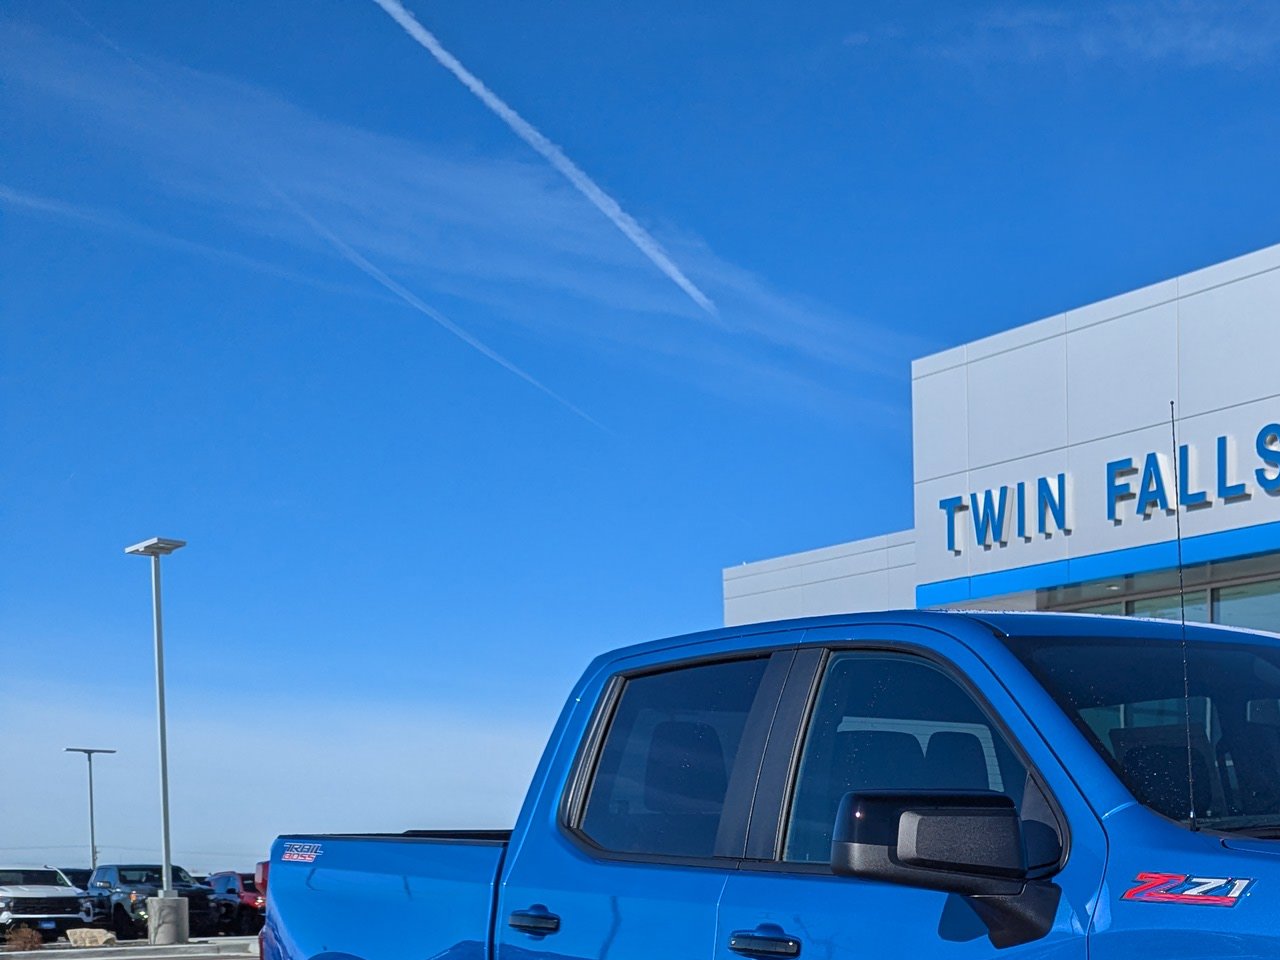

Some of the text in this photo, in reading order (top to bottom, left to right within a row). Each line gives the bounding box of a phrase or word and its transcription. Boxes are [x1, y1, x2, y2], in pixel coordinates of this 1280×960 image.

[940, 473, 1072, 555] TWIN
[282, 853, 316, 862] BOSS
[284, 843, 323, 855] TRAIL
[1121, 872, 1253, 907] Z71
